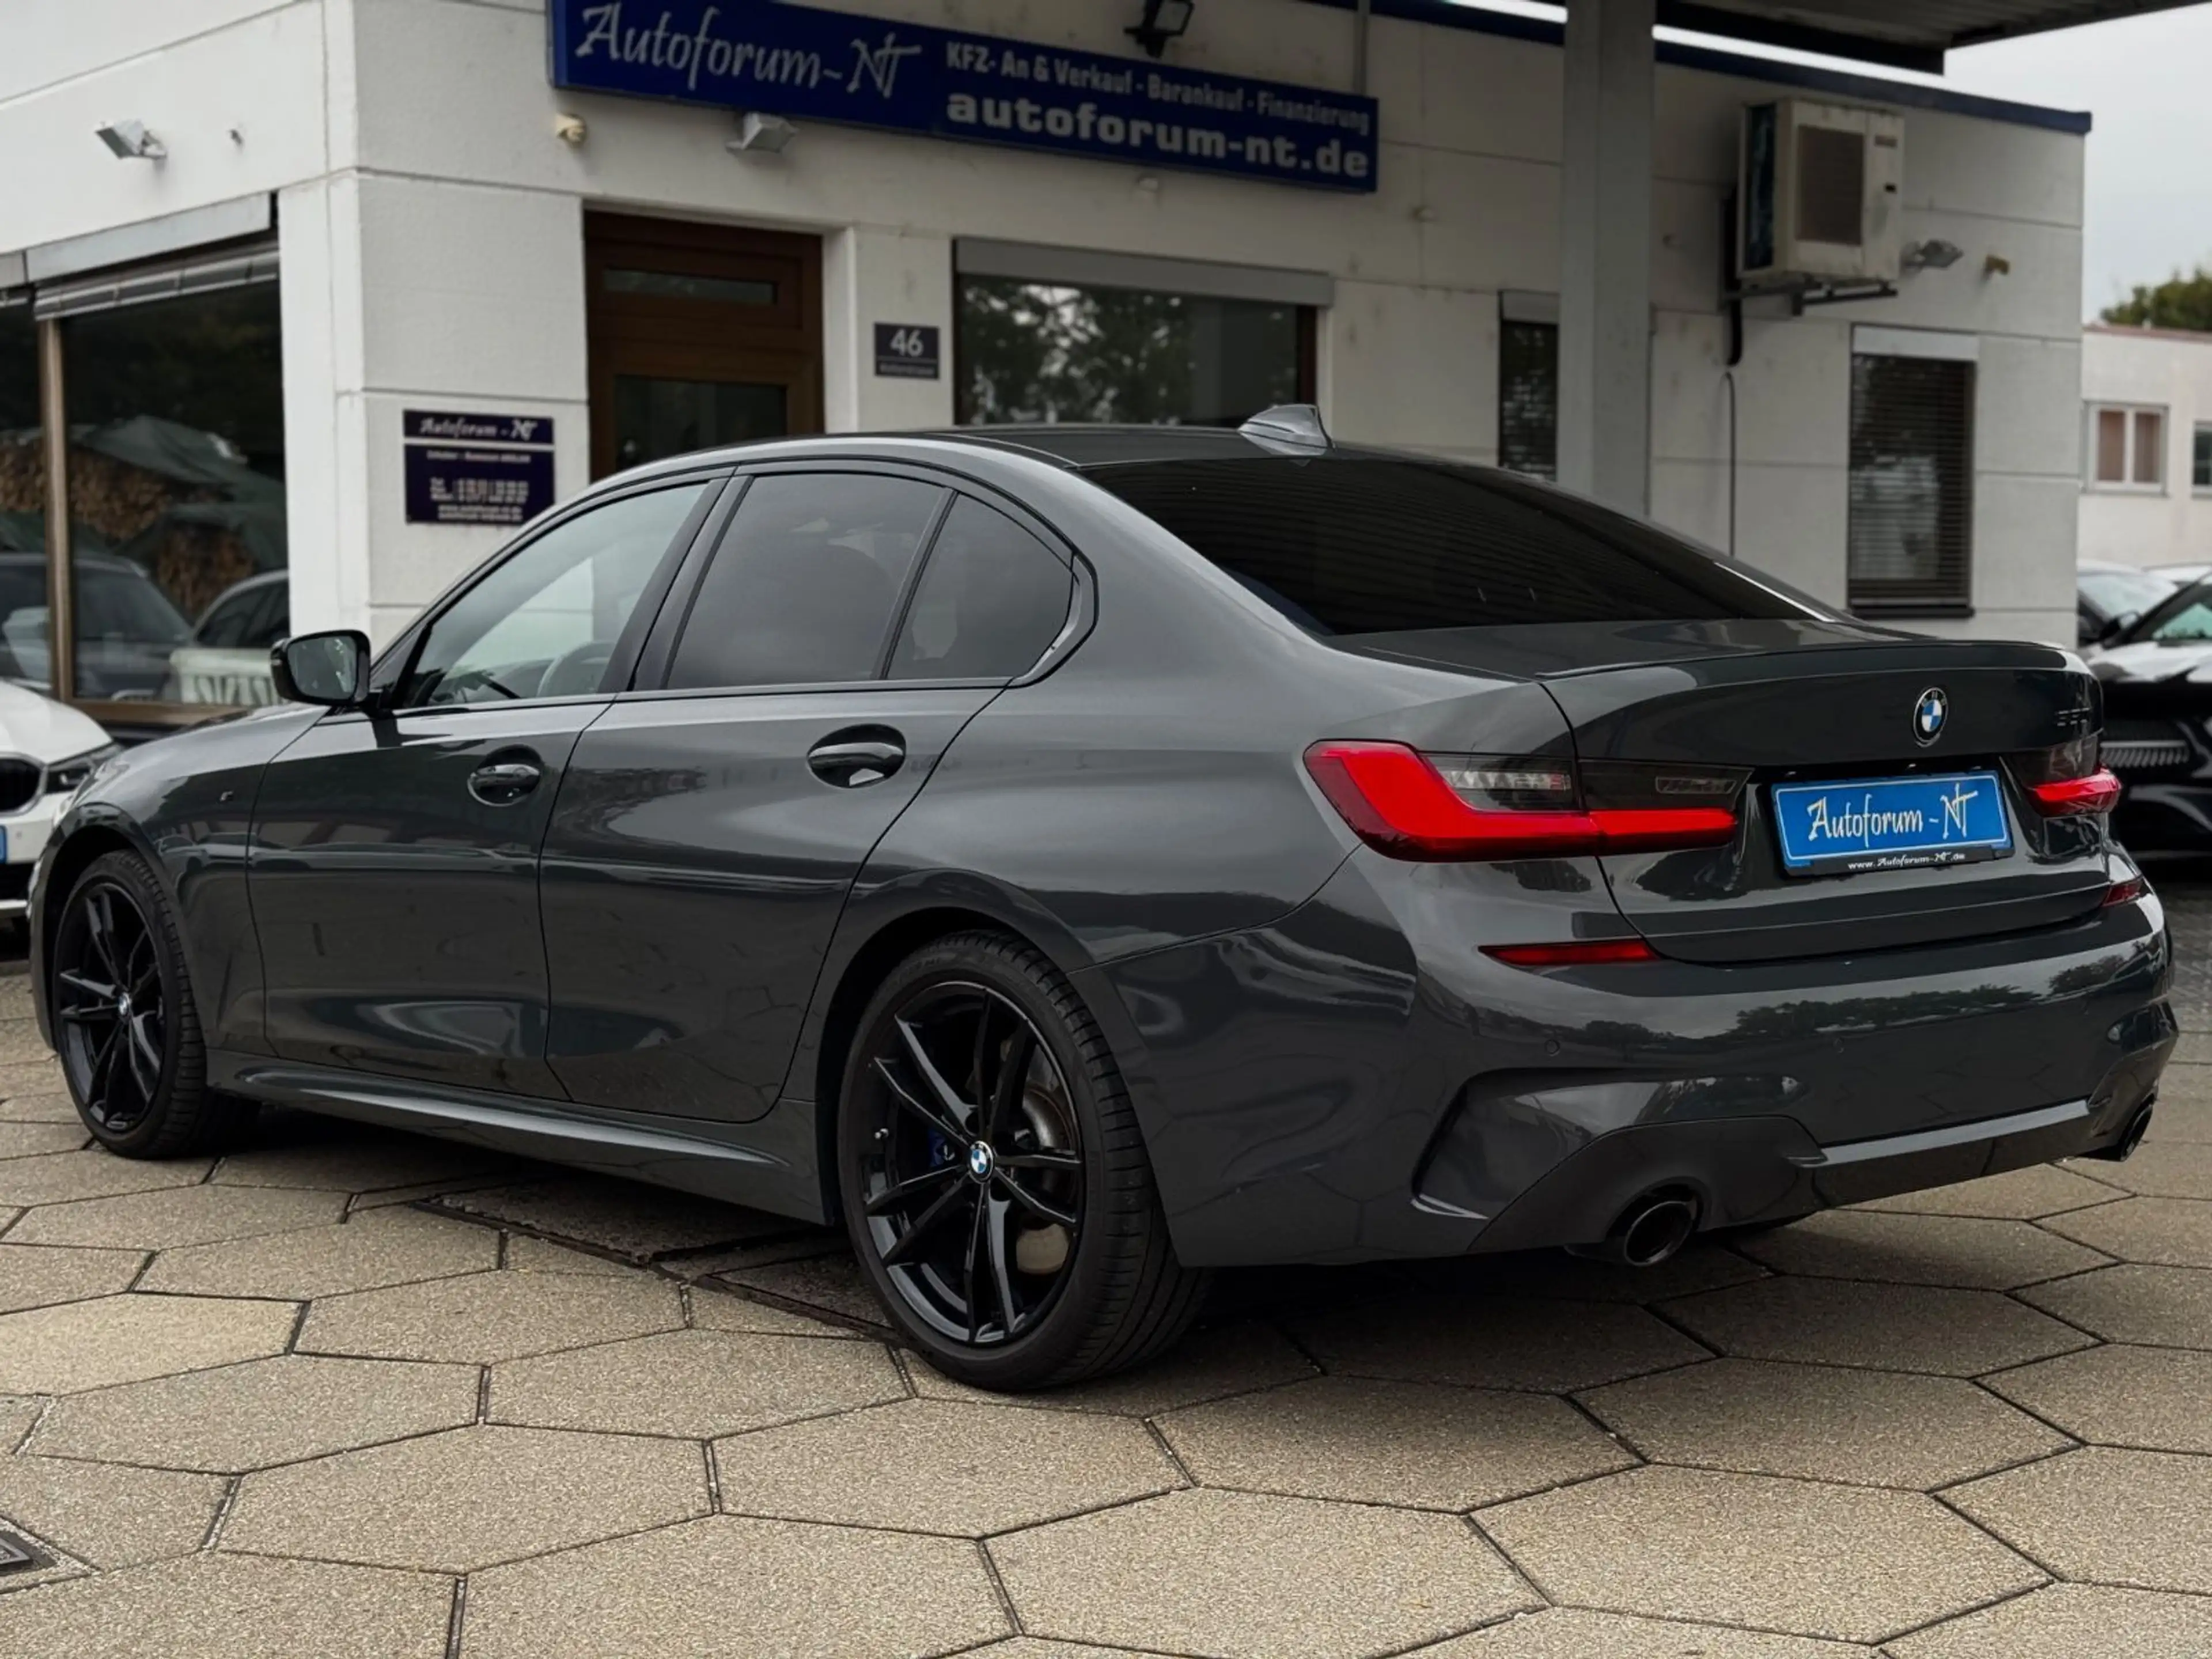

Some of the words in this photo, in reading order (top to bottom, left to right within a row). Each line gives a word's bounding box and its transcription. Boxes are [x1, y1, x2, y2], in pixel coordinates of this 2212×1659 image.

[1000, 49, 1030, 80] An
[1033, 55, 1050, 82] &
[1054, 58, 1134, 96] Verkauf
[1147, 73, 1244, 112] Barankauf
[1256, 89, 1370, 136] Finanzierung
[946, 92, 1370, 177] autoforum-nt.de
[890, 328, 924, 357] 46
[1806, 793, 1924, 848] Autoforum
[1940, 783, 1978, 840] NT
